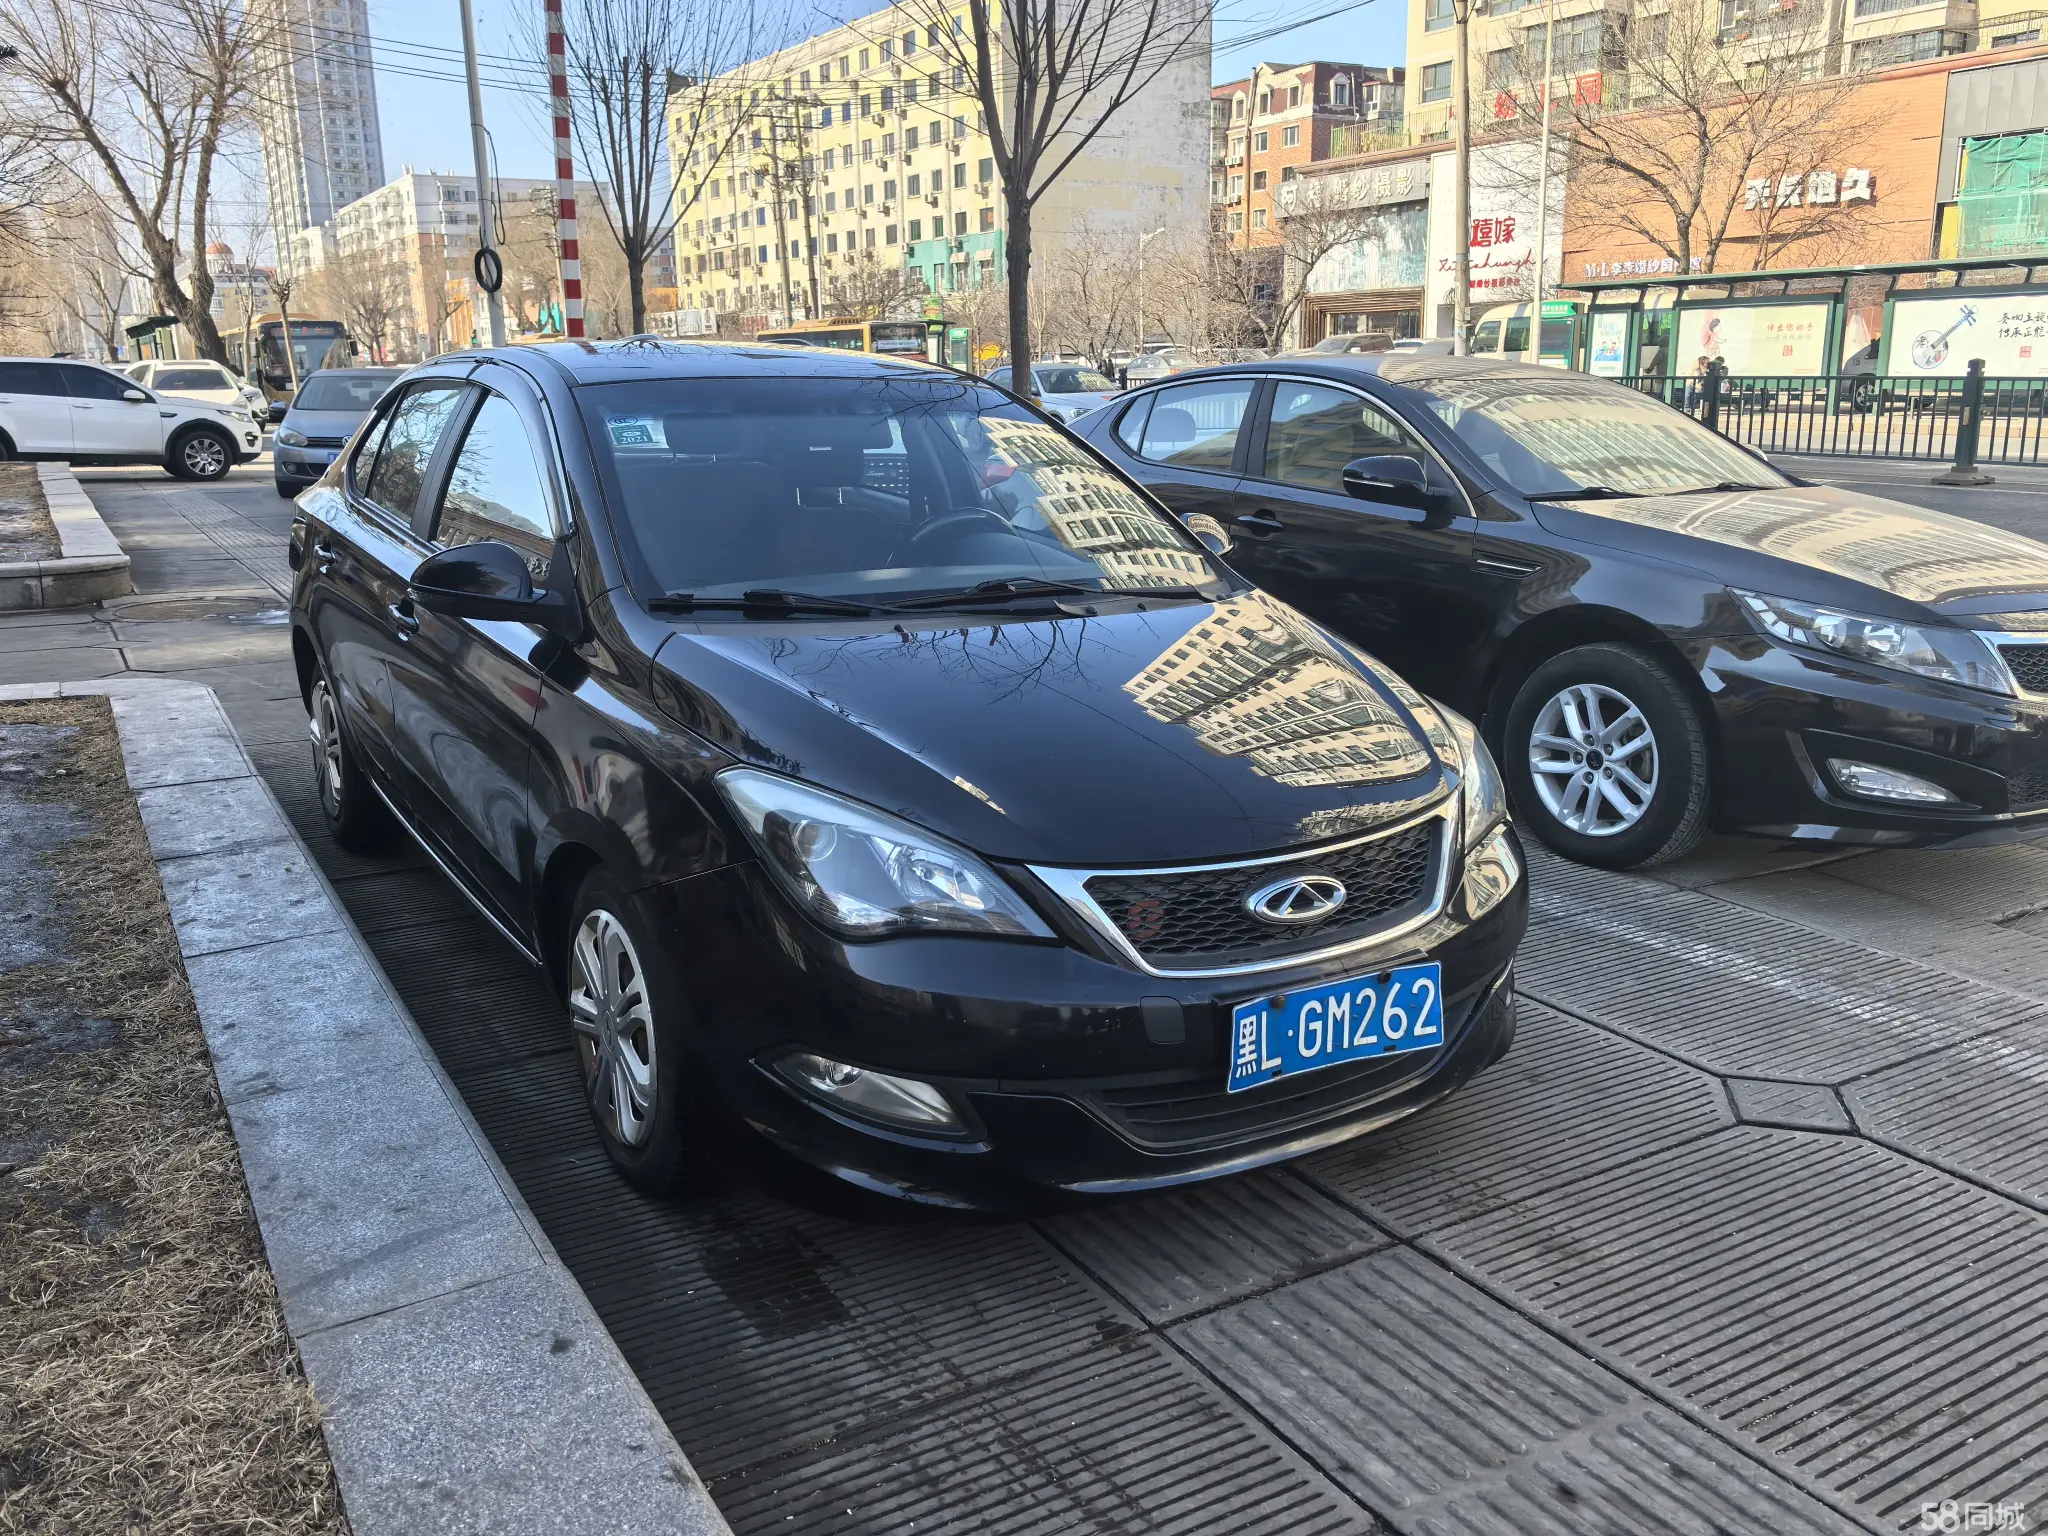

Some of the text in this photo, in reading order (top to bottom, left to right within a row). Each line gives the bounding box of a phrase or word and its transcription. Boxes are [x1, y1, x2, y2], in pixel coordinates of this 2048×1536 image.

[1997, 311, 2048, 325] 奏响主旋
[1998, 326, 2048, 339] 传承正能
[620, 435, 649, 444] 2021
[1235, 977, 1438, 1079] 黑L·GM262
